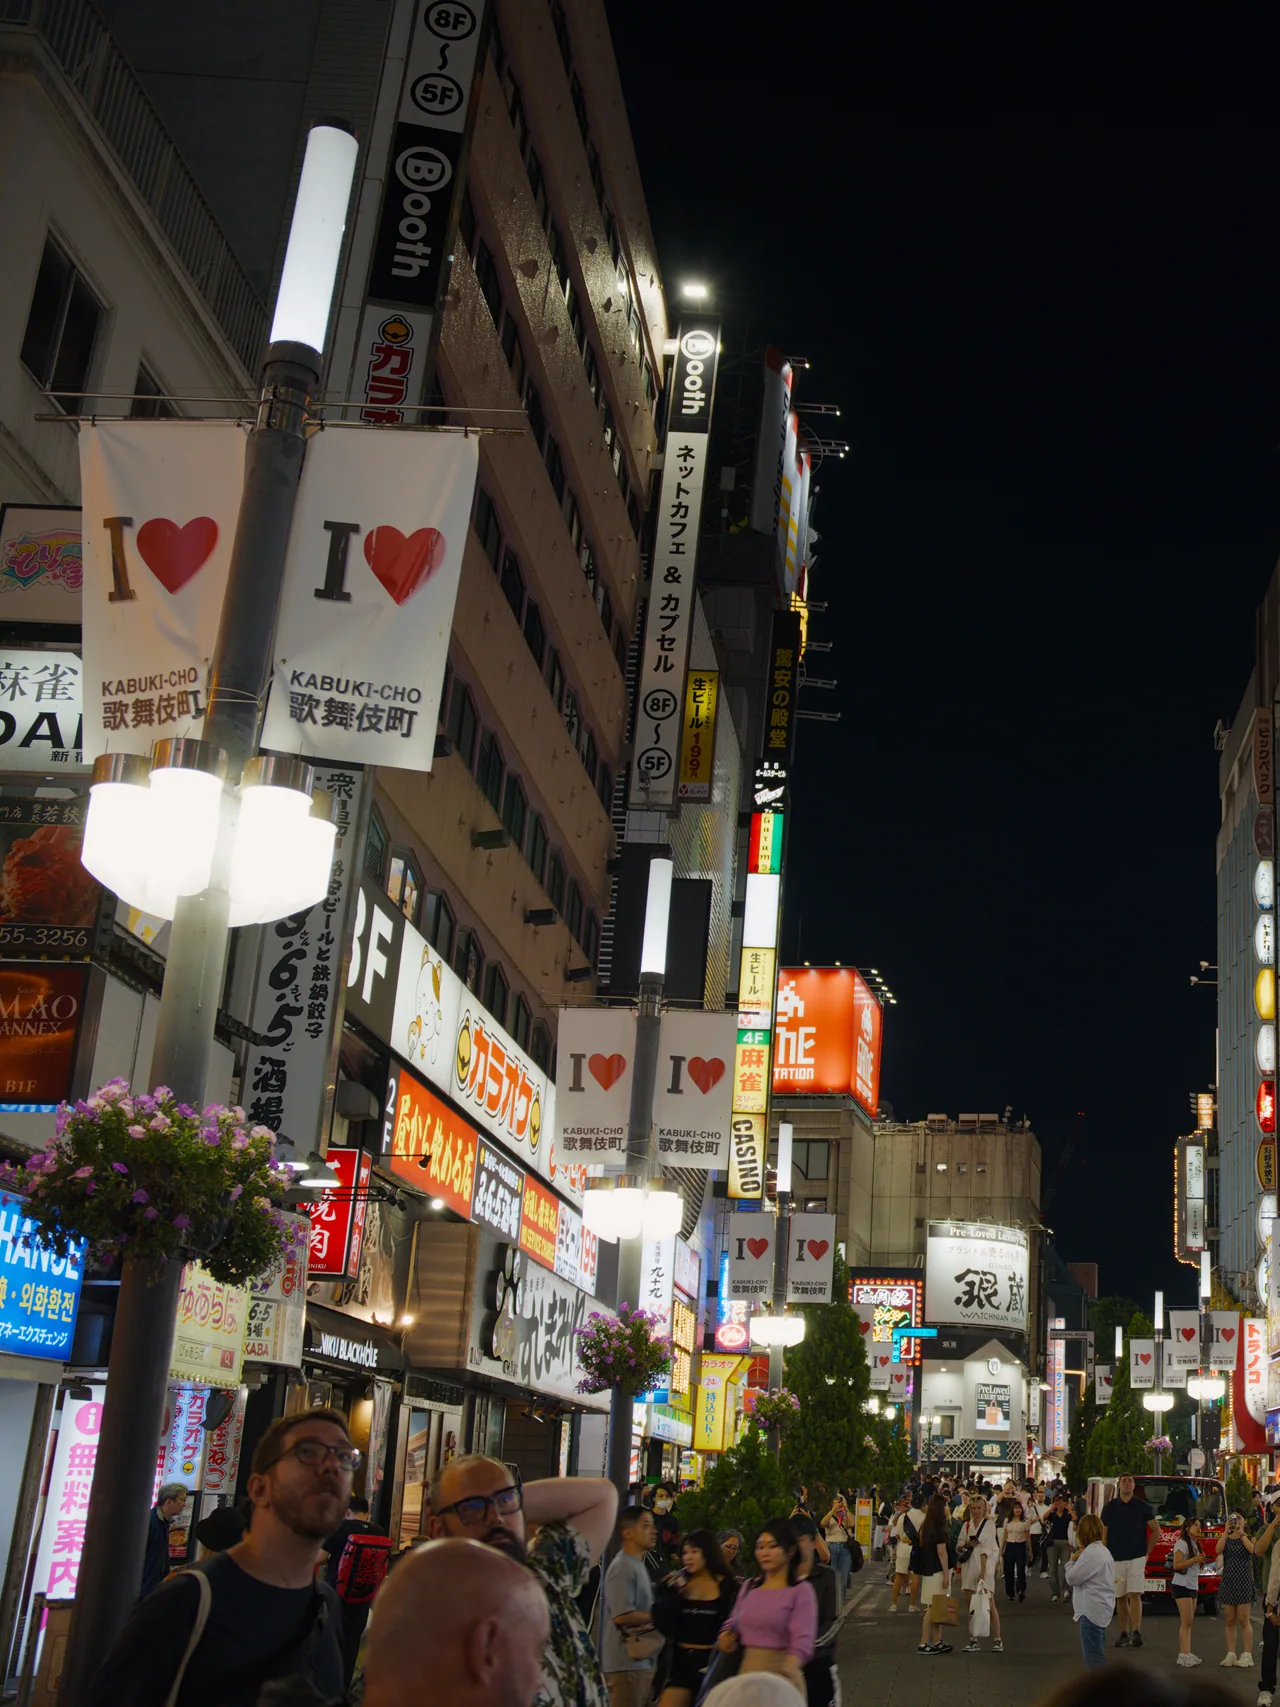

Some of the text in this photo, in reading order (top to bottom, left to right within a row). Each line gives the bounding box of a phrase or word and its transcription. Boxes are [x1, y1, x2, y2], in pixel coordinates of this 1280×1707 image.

[432, 9, 468, 32] 8F
[420, 83, 455, 108] 5F
[391, 145, 453, 280] Booth
[681, 330, 716, 415] Booth
[667, 444, 695, 556] ネットカフェ
[103, 516, 136, 603] I
[314, 520, 360, 603] I
[662, 566, 683, 585] &
[653, 593, 680, 674] カプセル
[102, 667, 199, 697] KABUKI-CHO
[290, 670, 423, 705] KABUKI-CHO
[767, 648, 796, 750] 驚安の殿堂
[102, 690, 206, 733] 歌舞伎町
[288, 691, 419, 739] 歌舞伎町
[648, 695, 671, 714] 8F
[689, 677, 707, 730] 生ビール
[643, 754, 666, 774] 5F
[747, 952, 762, 996] 生ビール
[742, 1031, 765, 1045] 4F
[468, 1022, 533, 1138] カラオケ
[568, 1053, 586, 1093] I
[666, 1055, 686, 1095] I
[738, 1048, 766, 1093] 麻雀
[562, 1128, 624, 1137] KABUKI-CHO
[562, 1137, 623, 1152] 歌舞伎町
[658, 1129, 722, 1140] KABUKI-CHO
[658, 1140, 721, 1156] 歌舞伎町
[731, 1118, 762, 1194] CASINO
[736, 1237, 746, 1261] I
[795, 1239, 807, 1262] I
[949, 1226, 996, 1240] Pre-Loved
[647, 1266, 665, 1299] 九十九
[732, 1284, 767, 1295] 歌舞伎町
[791, 1286, 827, 1296] 歌舞伎町
[953, 1267, 1025, 1318] 銀蔵
[701, 1359, 736, 1369] カラオケ
[1247, 1323, 1261, 1384] トラノコ
[977, 1384, 1010, 1395] PreLoved
[182, 1393, 206, 1460] カラオケ
